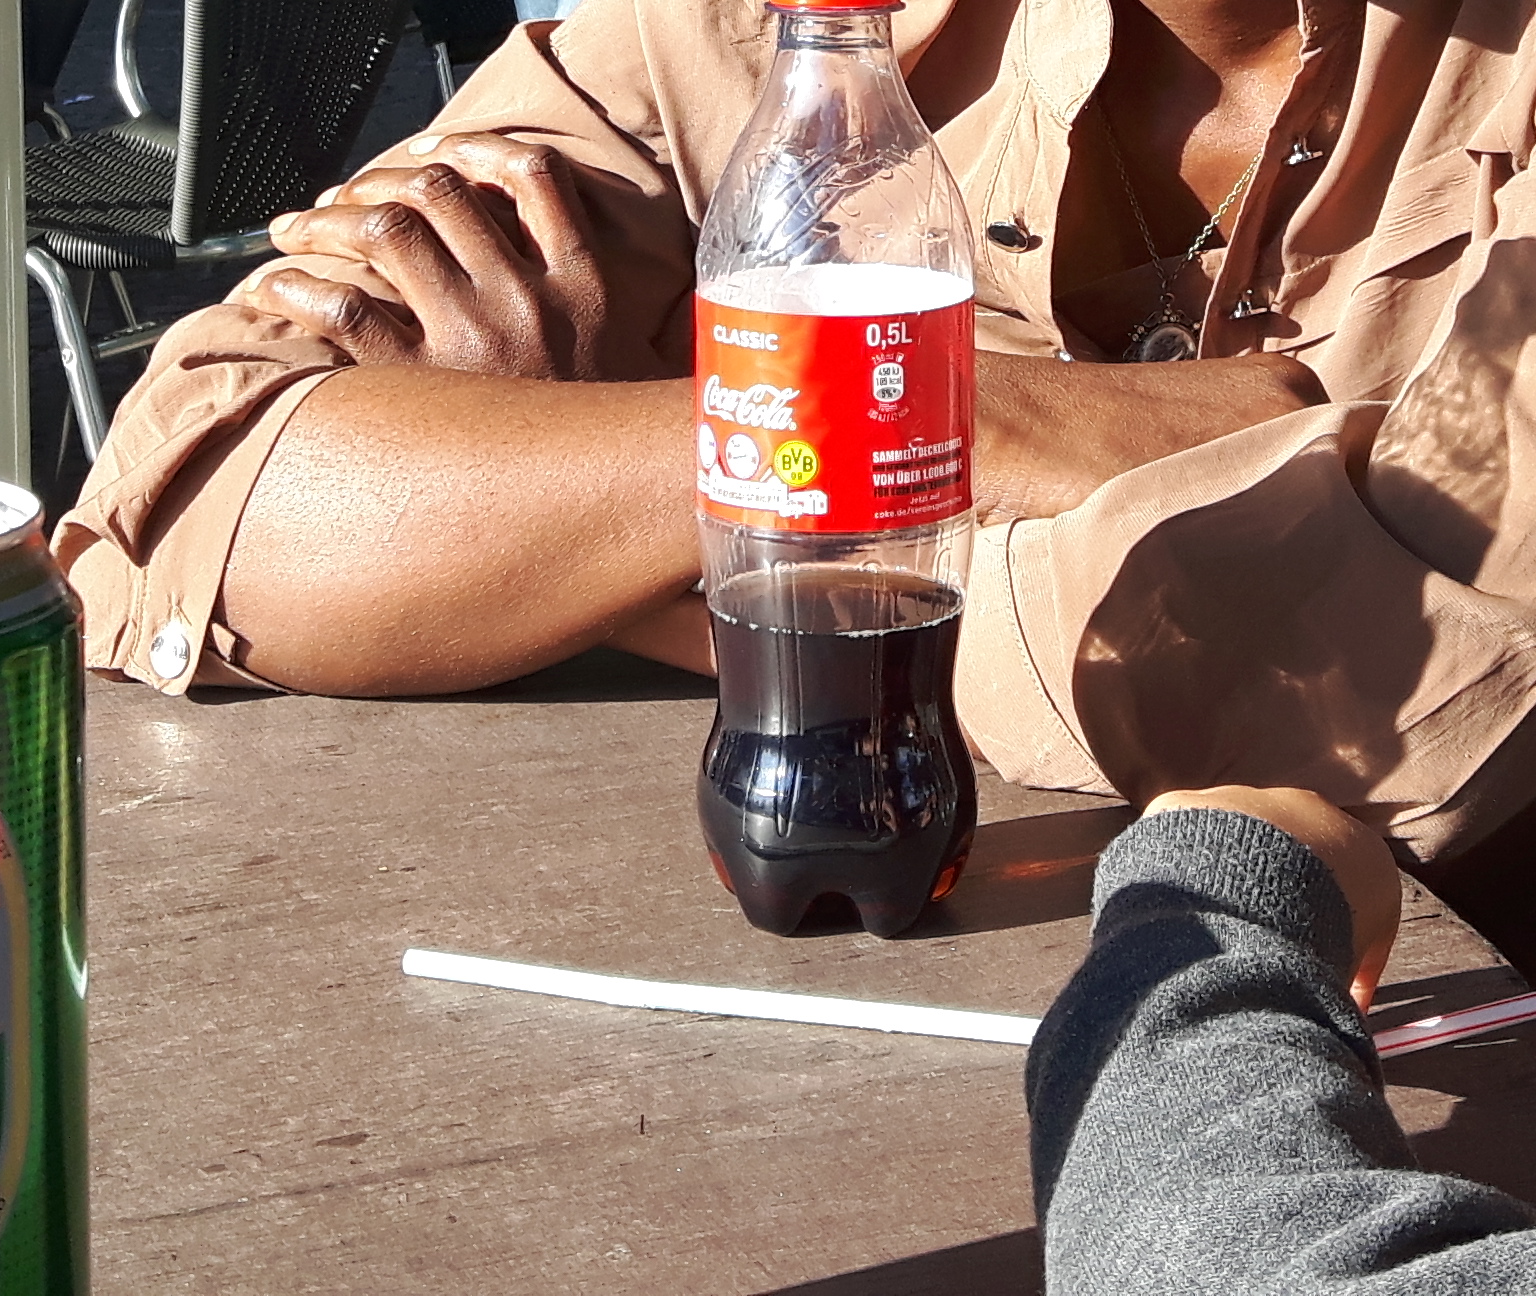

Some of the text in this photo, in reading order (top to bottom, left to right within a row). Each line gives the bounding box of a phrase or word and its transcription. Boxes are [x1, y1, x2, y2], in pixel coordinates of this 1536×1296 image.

[713, 324, 779, 351] CLASSIC
[866, 321, 913, 350] 0,5L
[782, 447, 814, 472] BVB
[872, 447, 917, 463] SAMMELT
[873, 472, 895, 487] VON
[896, 468, 921, 485] ÜBER
